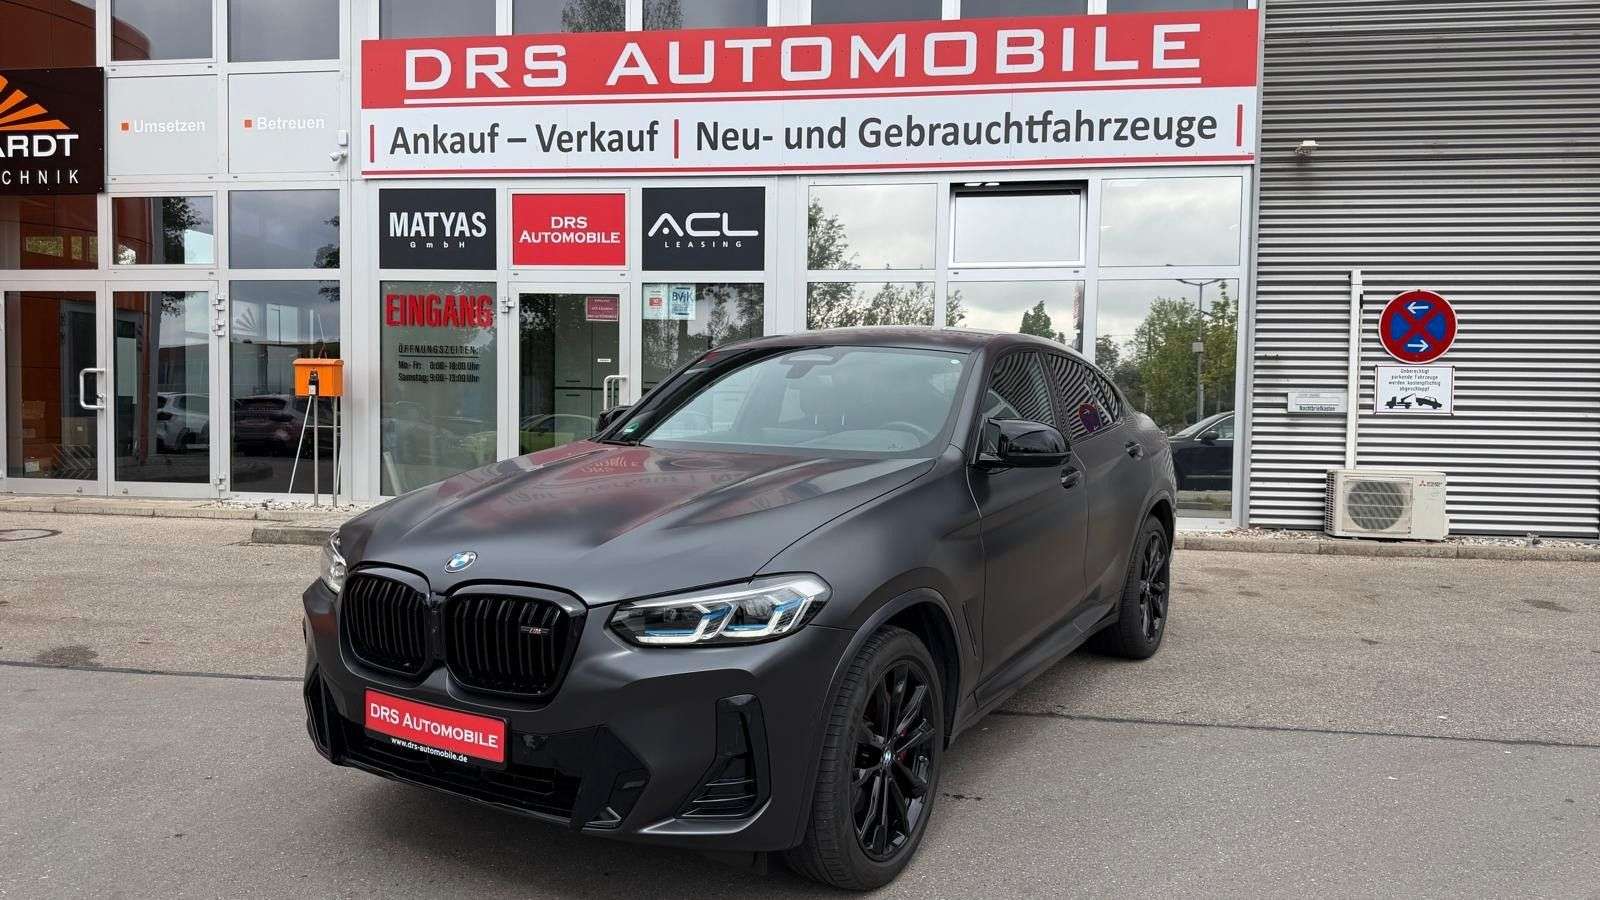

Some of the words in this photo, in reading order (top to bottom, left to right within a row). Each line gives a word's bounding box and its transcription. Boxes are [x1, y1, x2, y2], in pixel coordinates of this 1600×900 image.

[405, 45, 568, 91] DRS
[605, 23, 1202, 86] AUTOMOBILE
[133, 120, 206, 133] Umsetzen
[256, 116, 325, 131] Betreuen
[389, 123, 500, 155] Ankauf
[535, 120, 660, 153] Verkauf
[696, 120, 774, 151] Neu-
[784, 116, 847, 150] und
[858, 110, 1218, 148] Gebrauchtfahrzeuge
[0, 134, 80, 158] RDT
[389, 211, 487, 238] MATYAS
[550, 215, 588, 229] DRS
[647, 212, 759, 237] ACL
[518, 229, 621, 244] AUTOMOBILE
[664, 240, 743, 249] LEASING
[384, 293, 494, 329] EINGANG
[370, 702, 400, 726] DRS
[402, 712, 499, 749] AUTOMOBILE
[391, 737, 468, 763] www.drs-automobile.de
